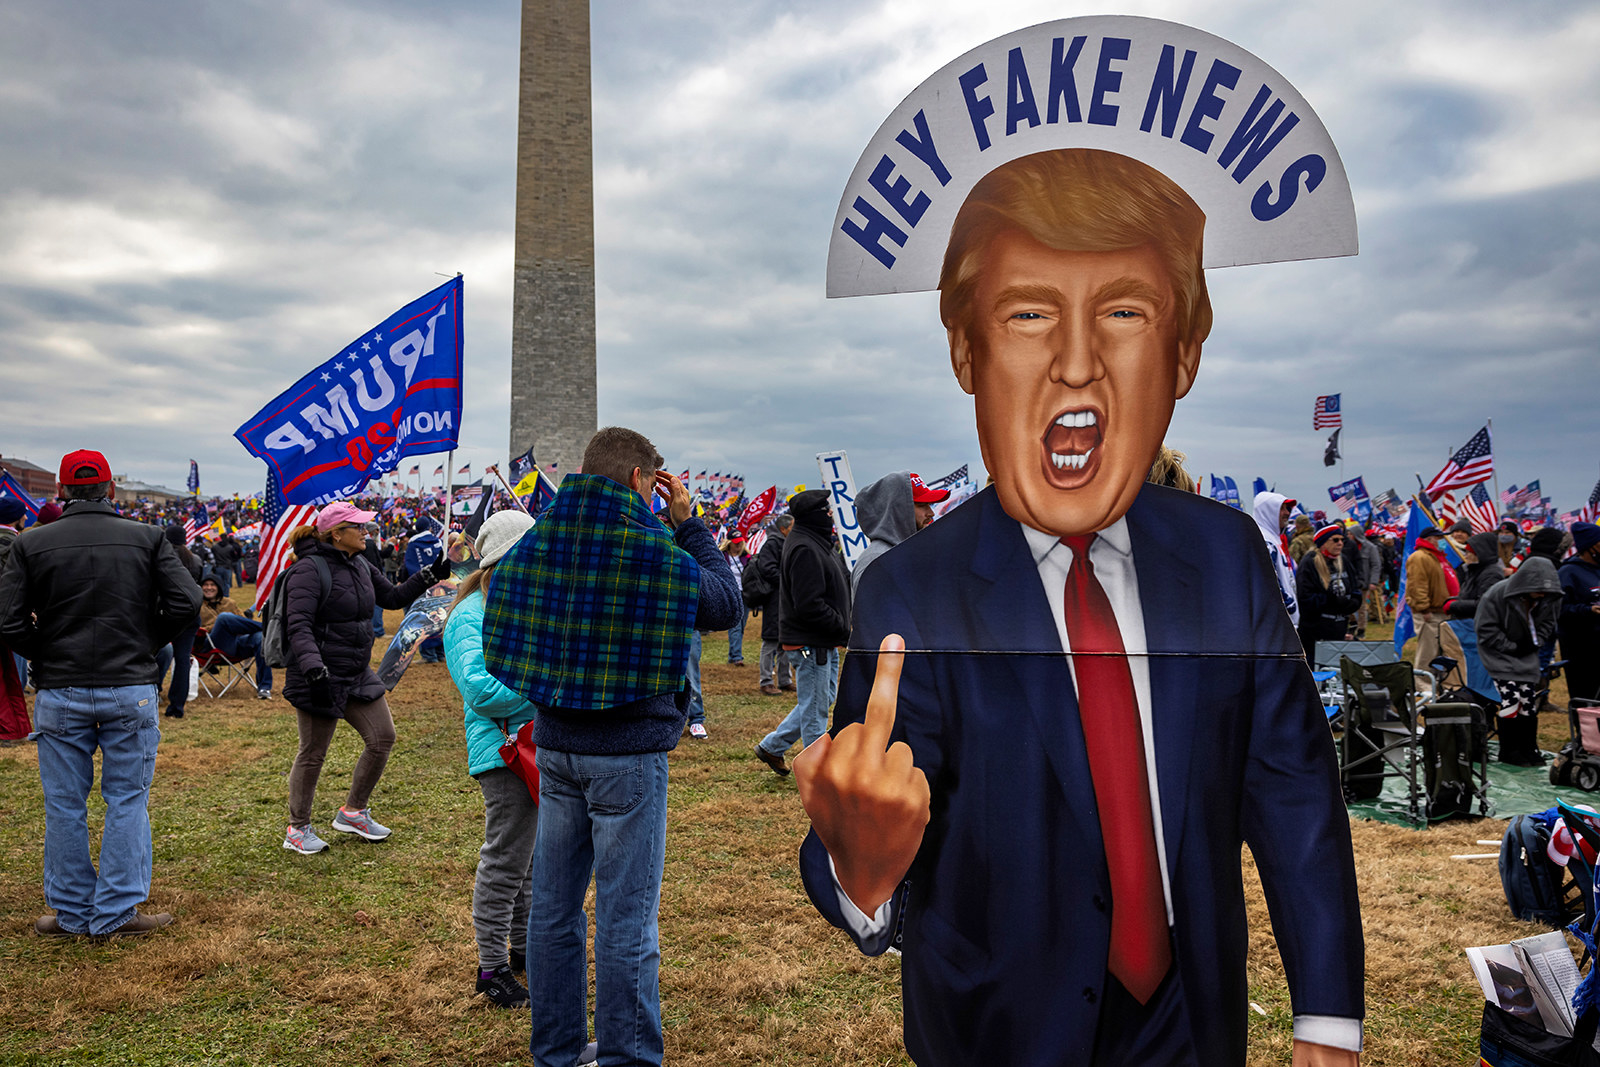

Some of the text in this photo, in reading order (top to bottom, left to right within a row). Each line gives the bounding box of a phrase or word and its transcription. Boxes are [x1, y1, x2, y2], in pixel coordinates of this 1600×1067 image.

[840, 35, 1327, 270] HEY FAKE NEWS
[823, 456, 868, 568] TRUM
